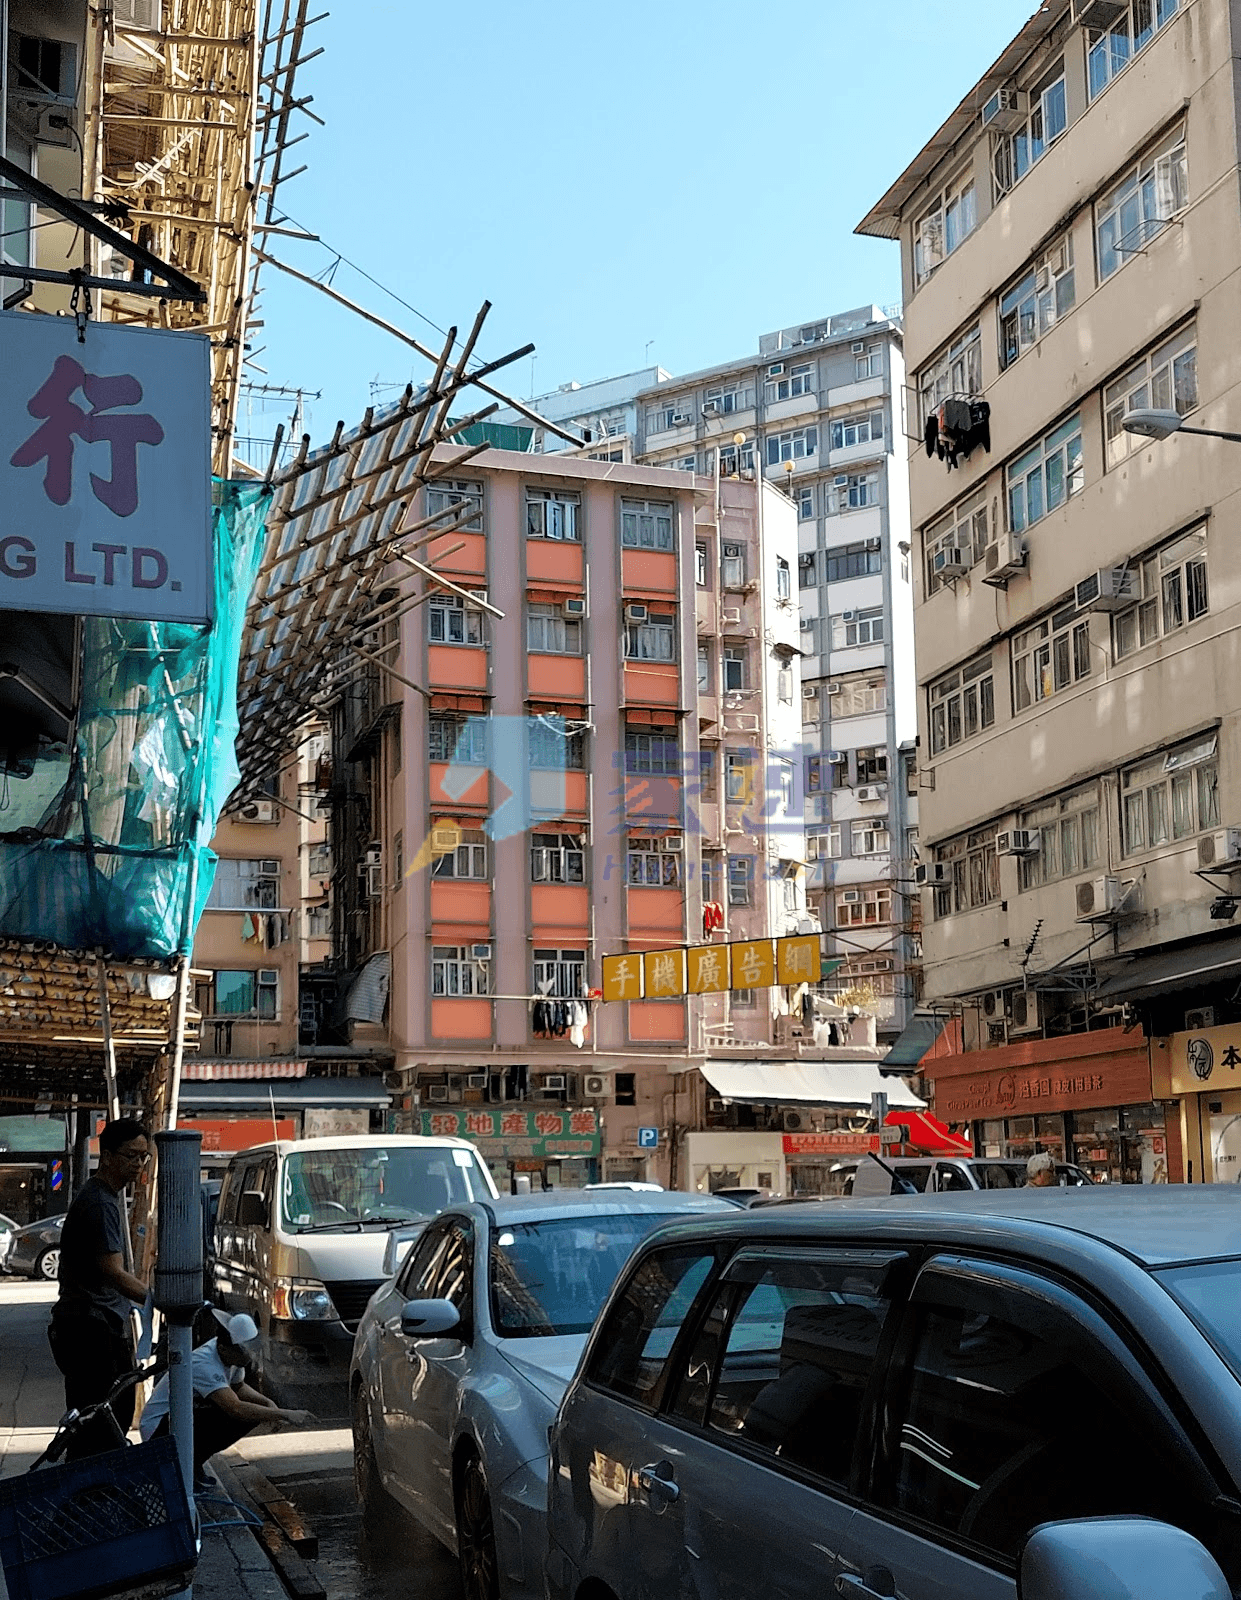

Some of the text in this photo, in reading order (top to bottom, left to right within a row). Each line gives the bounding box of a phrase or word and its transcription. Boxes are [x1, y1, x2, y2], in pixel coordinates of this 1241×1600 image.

[10, 354, 165, 518] 行
[64, 541, 182, 592] LTD.
[610, 943, 813, 997] 手機廣告網
[1220, 1045, 1241, 1070] 本
